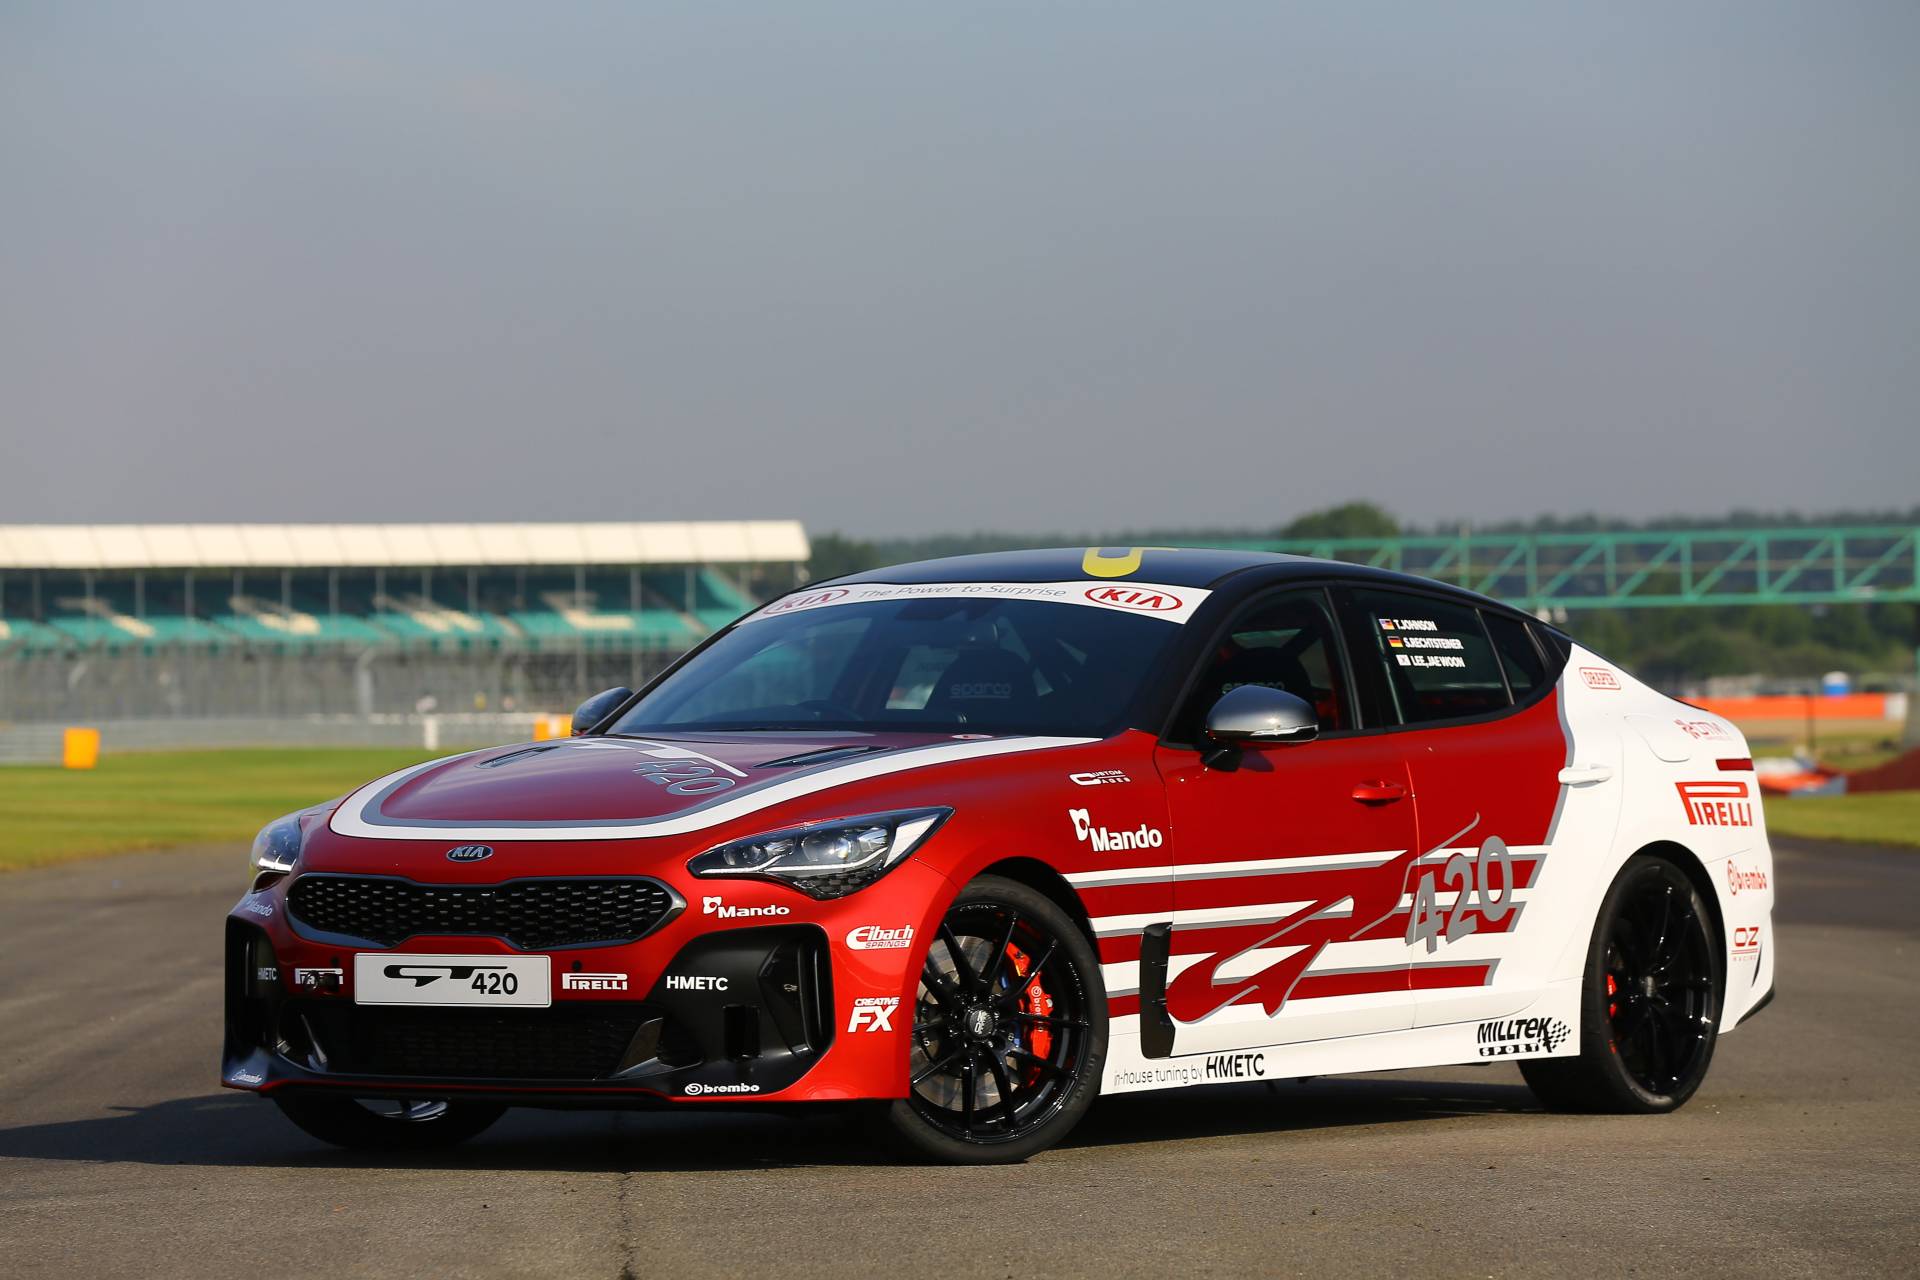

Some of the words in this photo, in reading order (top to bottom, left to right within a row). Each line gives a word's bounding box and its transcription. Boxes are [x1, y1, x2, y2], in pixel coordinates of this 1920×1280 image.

[860, 589, 892, 598] The
[898, 585, 954, 595] Power
[960, 585, 981, 593] to
[985, 585, 1067, 597] Surprise
[1099, 588, 1165, 608] KIA
[1675, 781, 1752, 827] PIRELLI
[1089, 823, 1163, 852] Mando
[1736, 865, 1767, 889] brembo
[1405, 835, 1514, 955] 420
[717, 904, 790, 919] Mando
[846, 925, 914, 950] Eibach
[865, 940, 907, 949] SPRINGS
[1734, 926, 1759, 947] OZ
[472, 972, 518, 995] 420
[562, 972, 628, 990] PIRELLI
[666, 976, 728, 991] HMETC
[855, 997, 900, 1006] CREATIVE
[847, 1005, 898, 1032] FX
[1481, 1044, 1538, 1056] SPORT
[1113, 1068, 1153, 1087] in-house
[1155, 1065, 1188, 1085] tuning
[1190, 1065, 1203, 1082] by
[1206, 1053, 1265, 1079] HMETC
[703, 1082, 760, 1094] brembo
